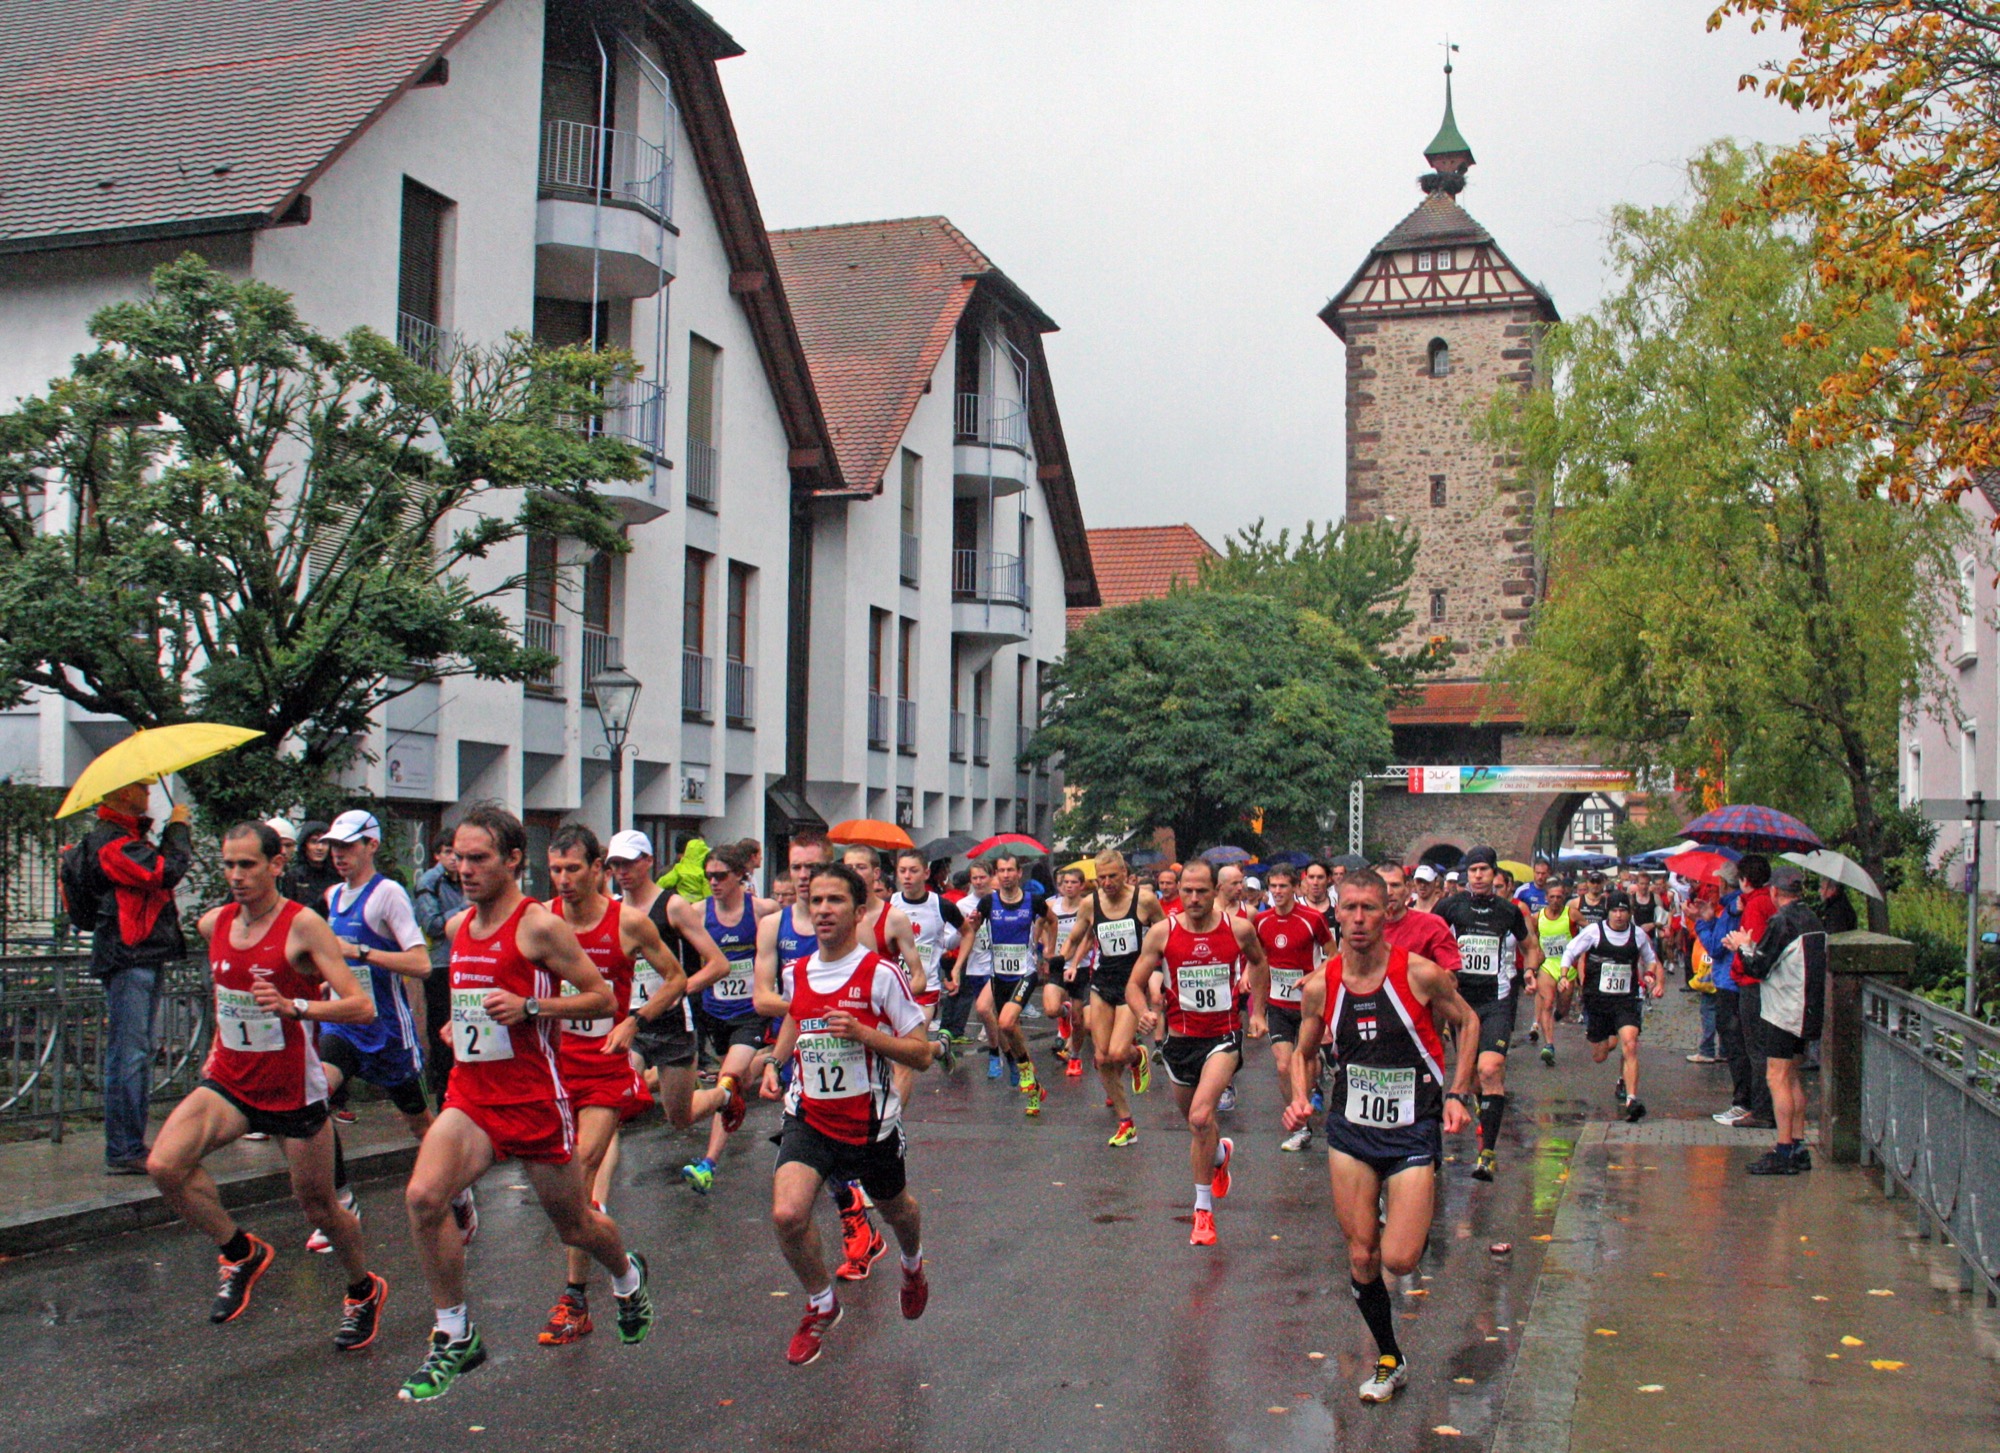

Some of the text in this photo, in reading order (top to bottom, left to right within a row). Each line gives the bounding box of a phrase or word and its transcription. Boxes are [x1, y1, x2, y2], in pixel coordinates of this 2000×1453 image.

[1099, 920, 1134, 932] BARMER
[1111, 937, 1127, 953] 79
[1548, 945, 1564, 956] 239
[1001, 958, 1020, 972] 109
[1465, 953, 1491, 971] 309
[1180, 967, 1229, 979] BARMER
[720, 979, 747, 996] 322
[1606, 977, 1625, 990] 330
[639, 983, 649, 1002] 4
[848, 986, 861, 998] LG
[1195, 988, 1216, 1009] 98
[838, 1000, 868, 1009] Erlangen
[801, 1018, 829, 1031] SIEM
[237, 1021, 252, 1046] 1
[465, 1025, 480, 1055] 2
[801, 1051, 826, 1063] GEK
[817, 1066, 847, 1093] 12
[1349, 1067, 1414, 1083] BARMER
[1350, 1078, 1378, 1094] GEK
[1379, 1089, 1413, 1097] experten
[1390, 1083, 1413, 1092] gesund
[1359, 1094, 1400, 1124] 105
